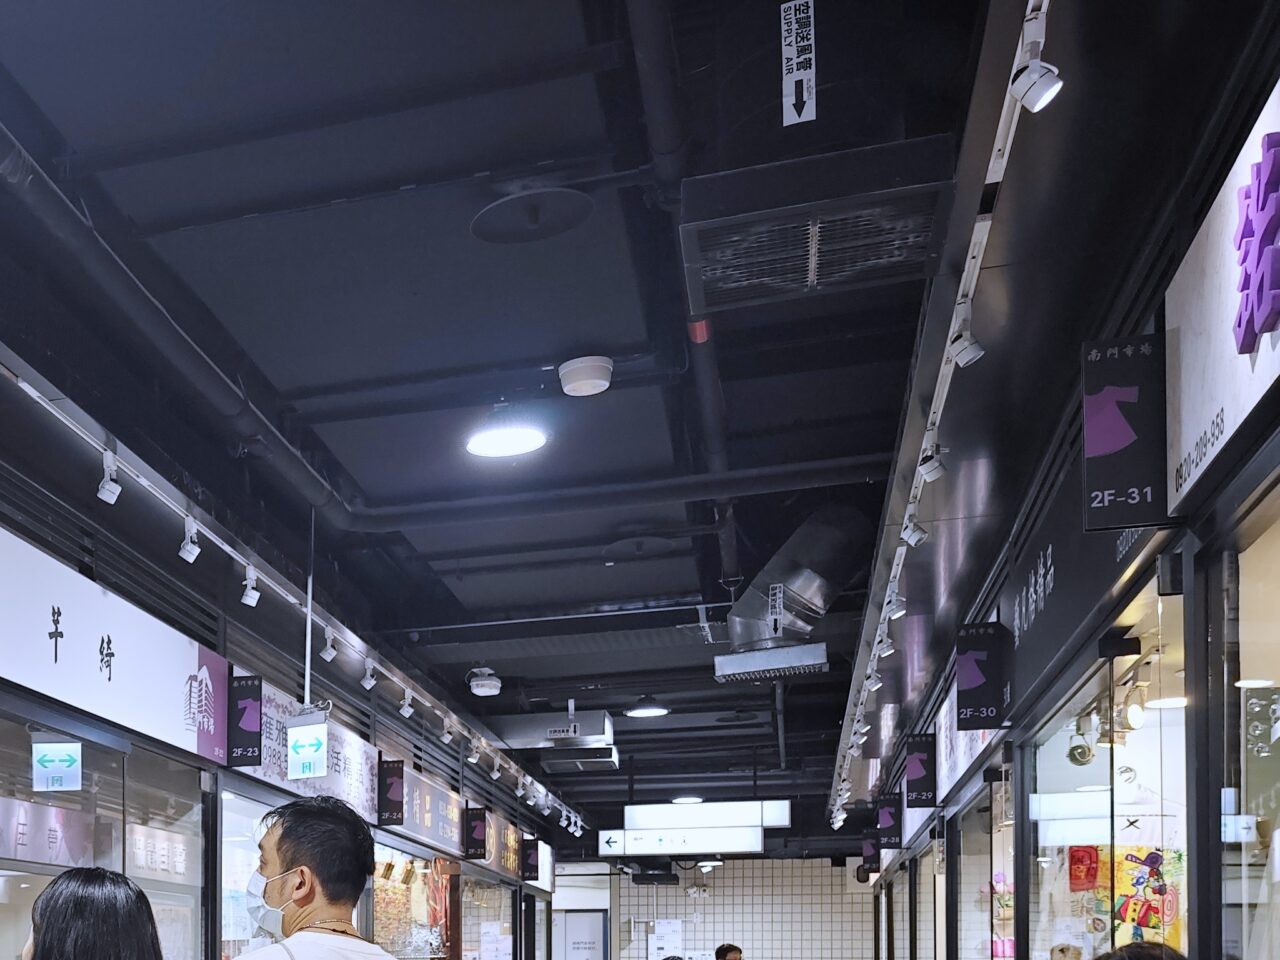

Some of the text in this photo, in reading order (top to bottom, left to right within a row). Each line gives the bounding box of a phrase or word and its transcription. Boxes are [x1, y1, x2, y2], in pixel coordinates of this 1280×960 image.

[783, 5, 794, 76] SUPPLY AIR
[794, 1, 812, 71] 空調送風管
[1087, 342, 1153, 361] 南門市場
[1175, 406, 1225, 494] 0920-209-958
[1090, 486, 1153, 509] 2F-31
[959, 707, 997, 719] 2F-30
[232, 747, 259, 757] 2F-23
[907, 791, 934, 800] 2F-29
